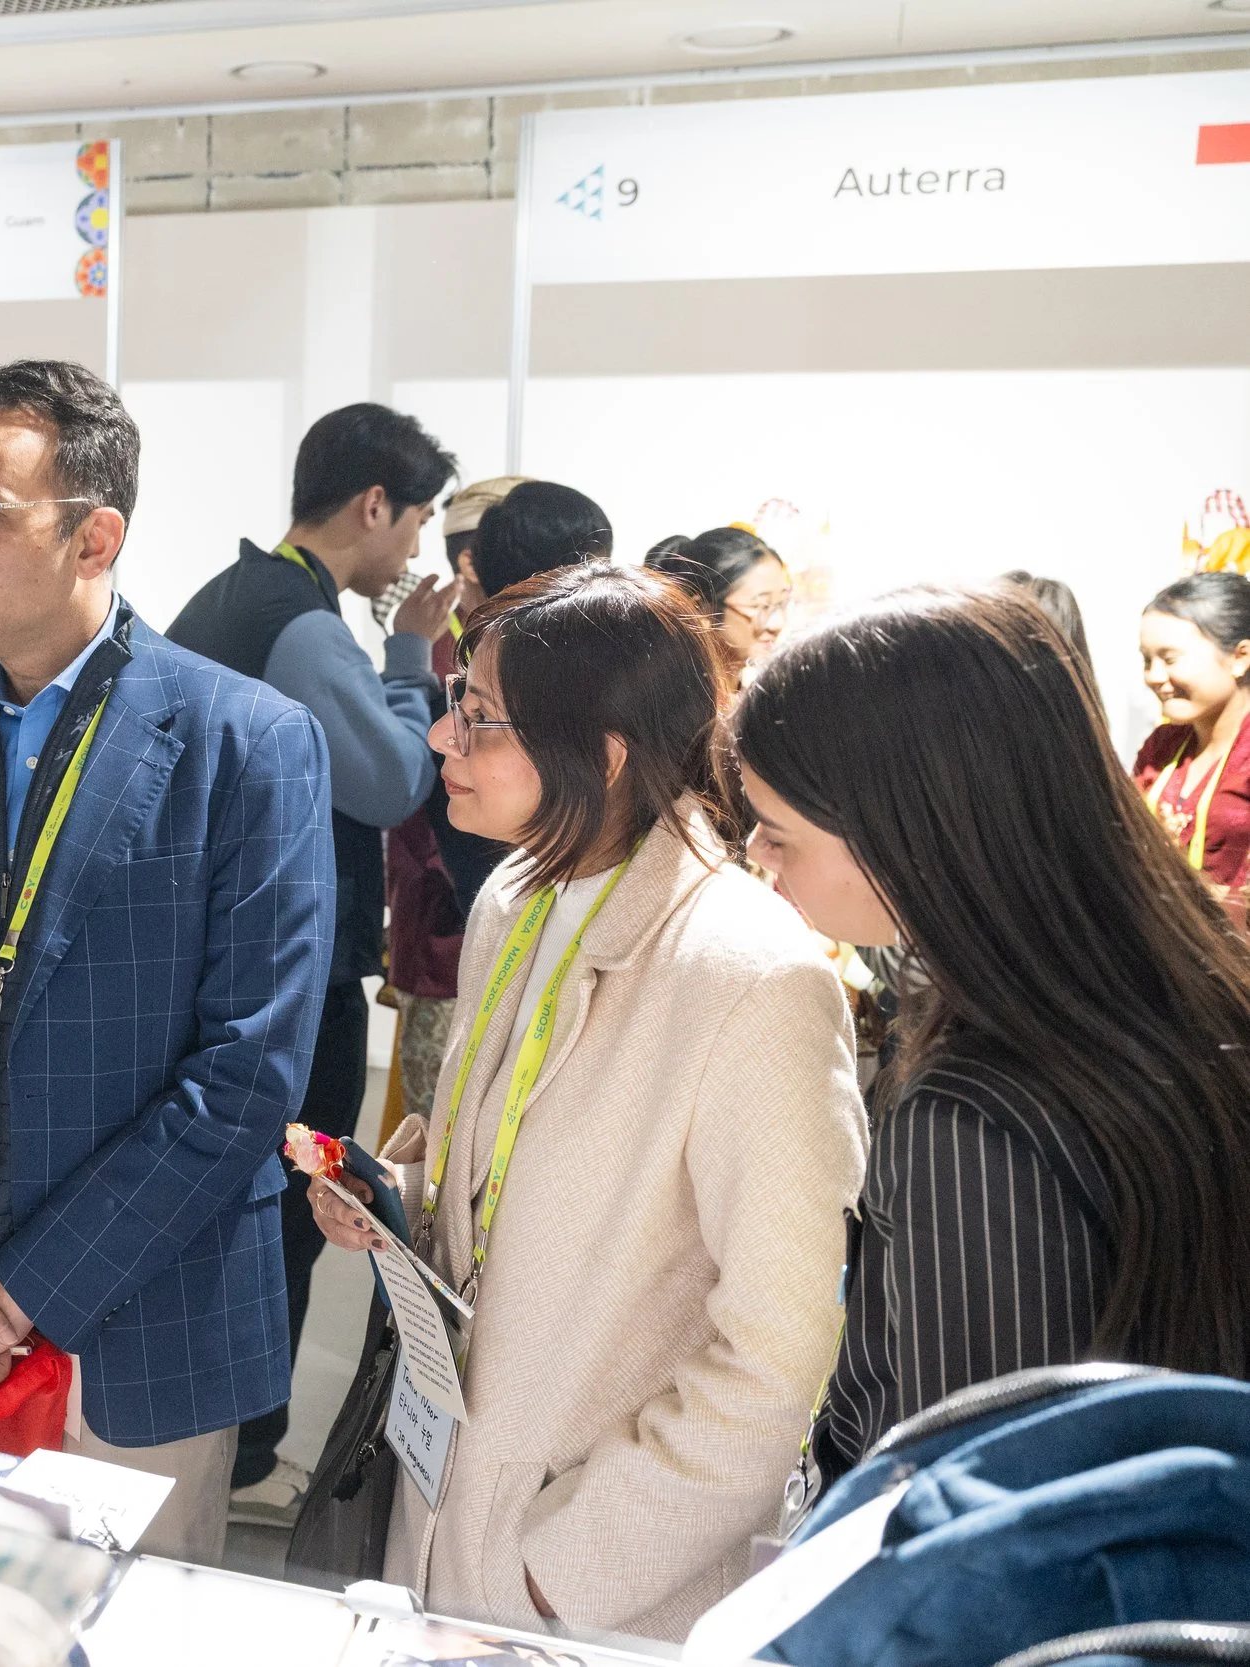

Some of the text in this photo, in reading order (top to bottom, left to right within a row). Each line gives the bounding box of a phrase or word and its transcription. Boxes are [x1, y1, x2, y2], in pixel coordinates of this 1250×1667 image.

[617, 178, 640, 207] 9
[833, 165, 1007, 199] Auterra
[483, 898, 547, 1013] KOREA MARCH 2026
[420, 1394, 439, 1422] Noor
[406, 1443, 431, 1486] Bangladesh
